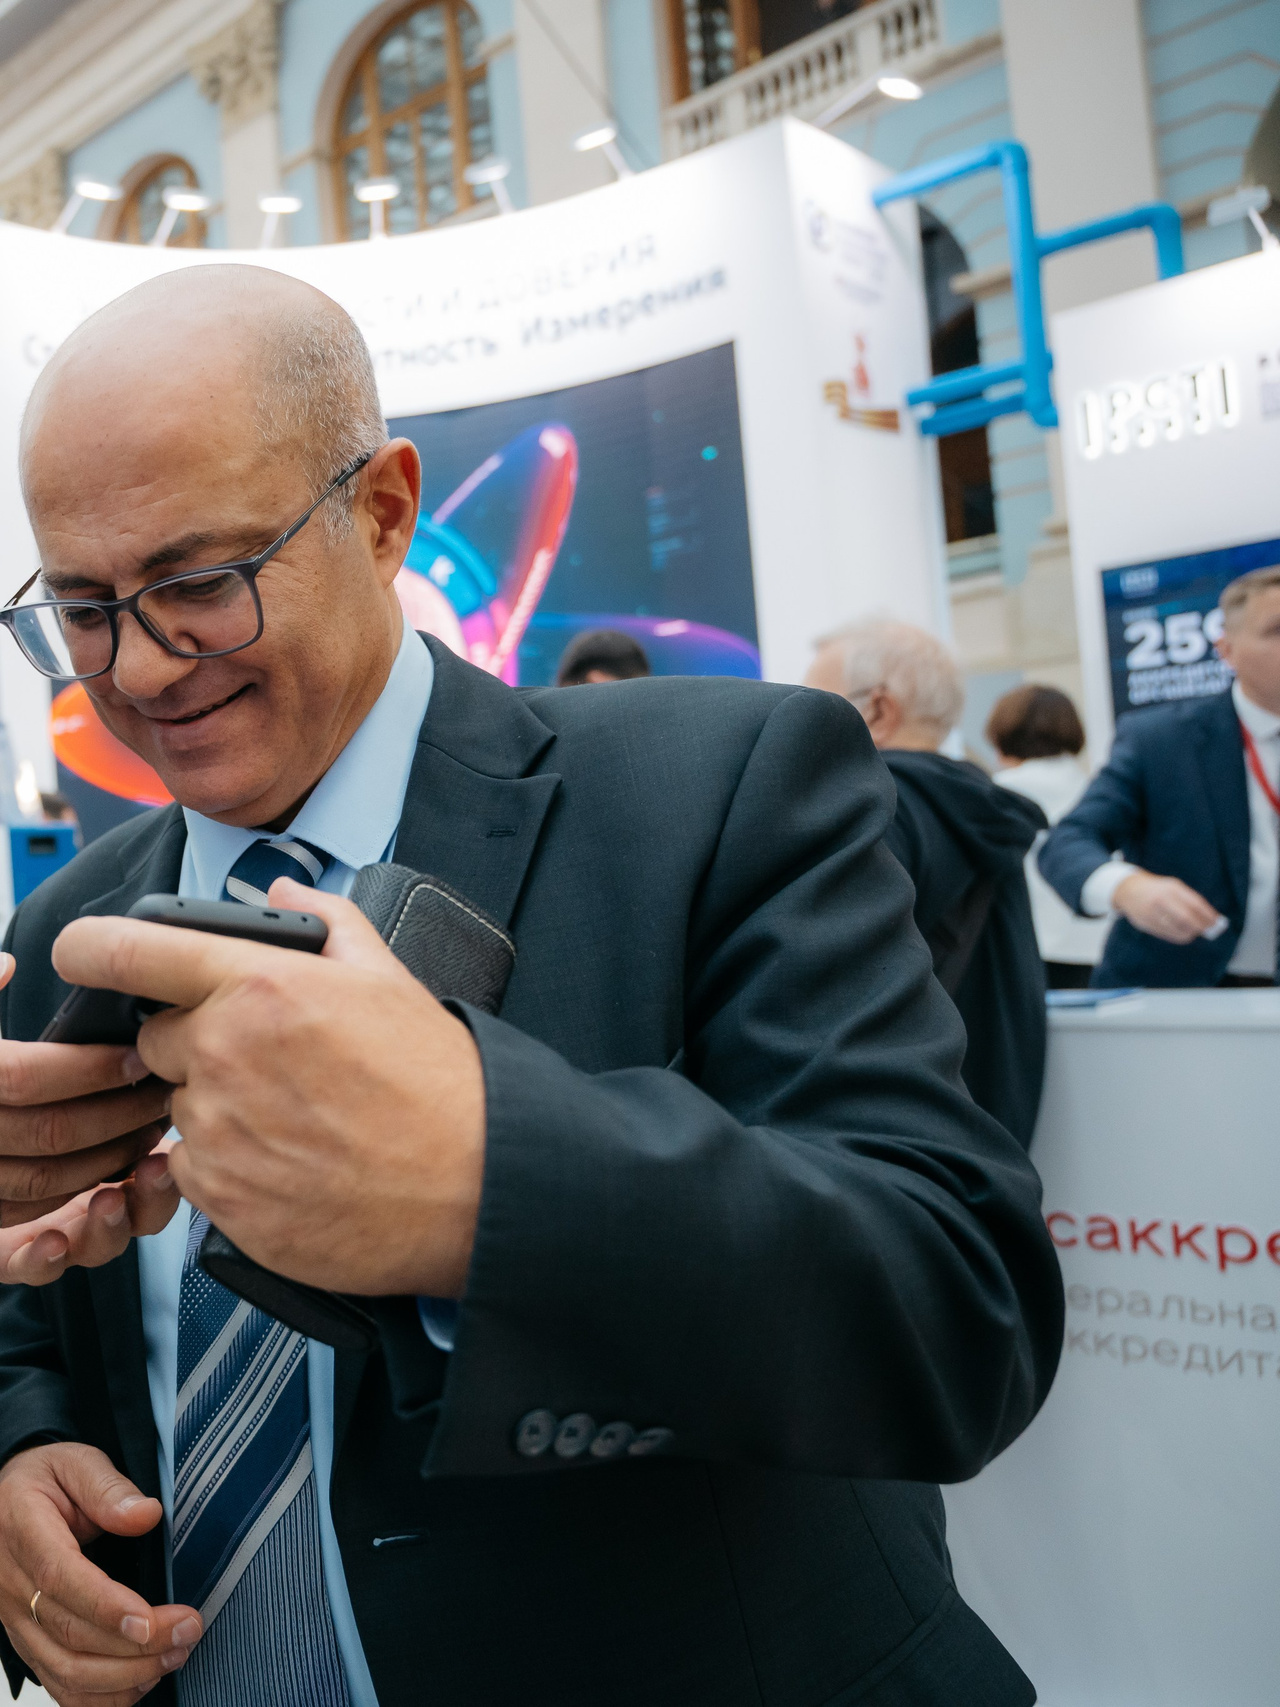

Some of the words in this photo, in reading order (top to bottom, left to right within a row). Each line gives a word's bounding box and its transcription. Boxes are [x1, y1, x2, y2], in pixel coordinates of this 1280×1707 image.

[478, 233, 656, 311] ДОВЕРИЯ
[374, 335, 501, 371] тность
[520, 264, 729, 348] Измерения
[1066, 1284, 1278, 1334] еральна
[1066, 1329, 1280, 1379] ккредит
